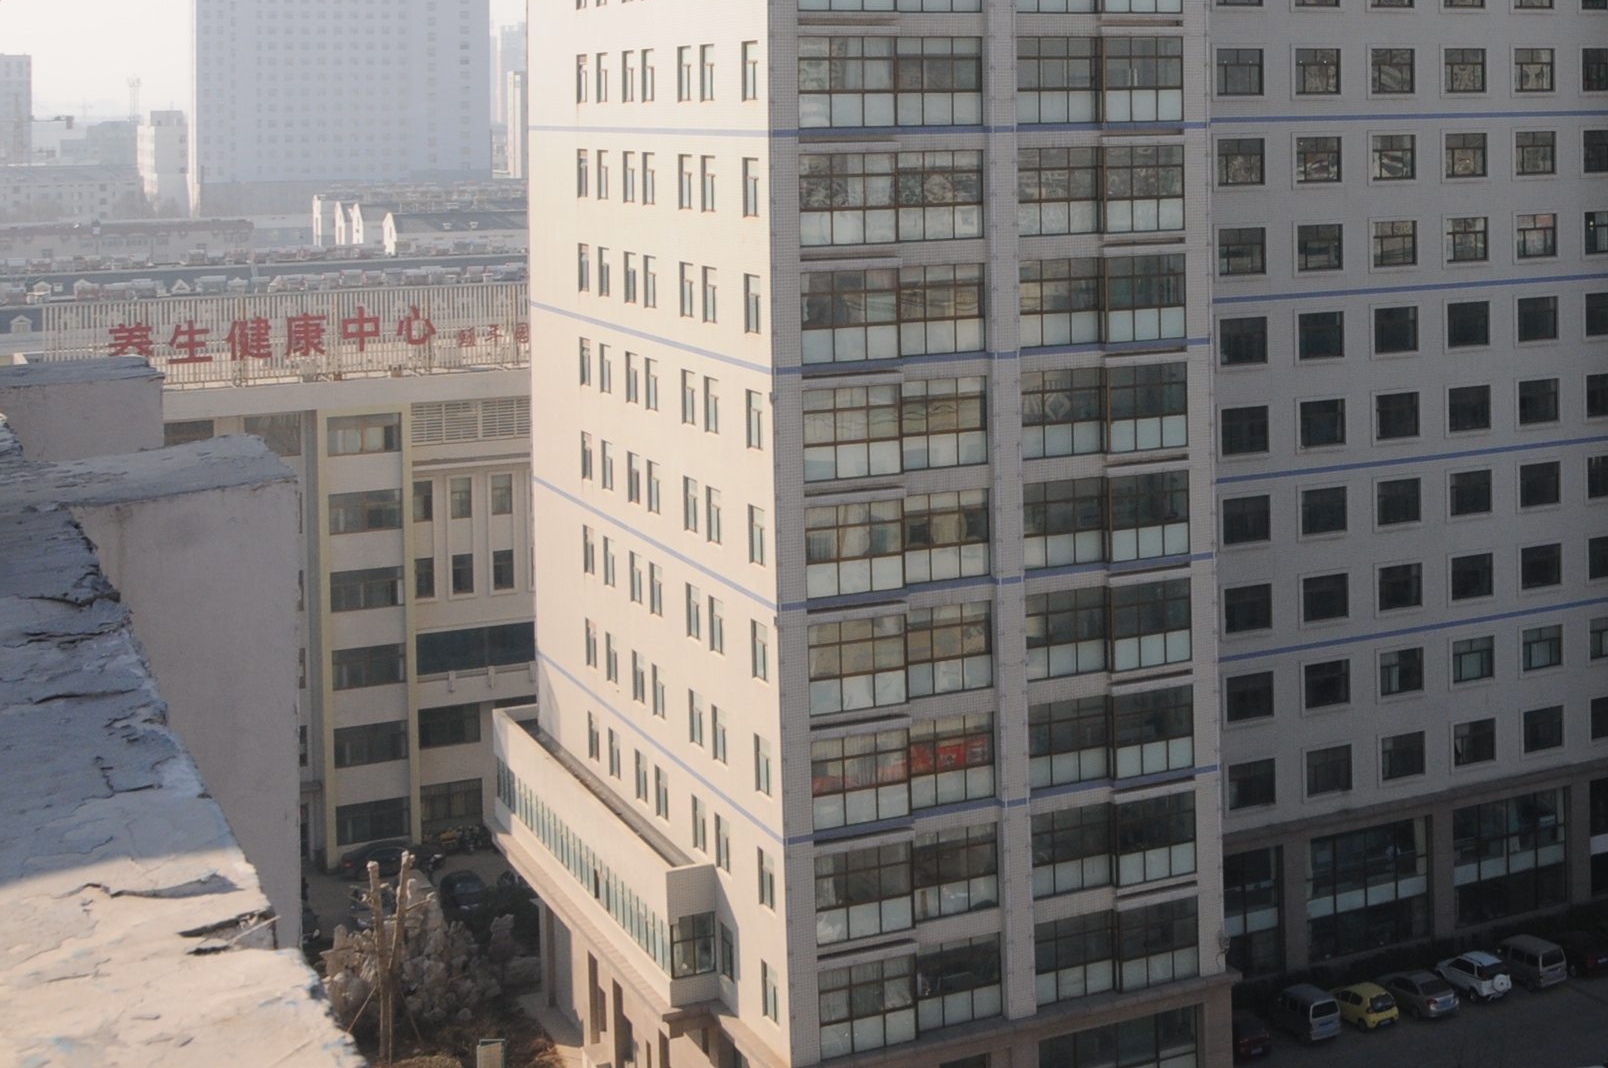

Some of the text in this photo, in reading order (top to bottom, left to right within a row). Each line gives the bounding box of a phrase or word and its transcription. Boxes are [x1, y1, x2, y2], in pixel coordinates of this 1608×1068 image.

[107, 305, 436, 365] 养生健康中心
